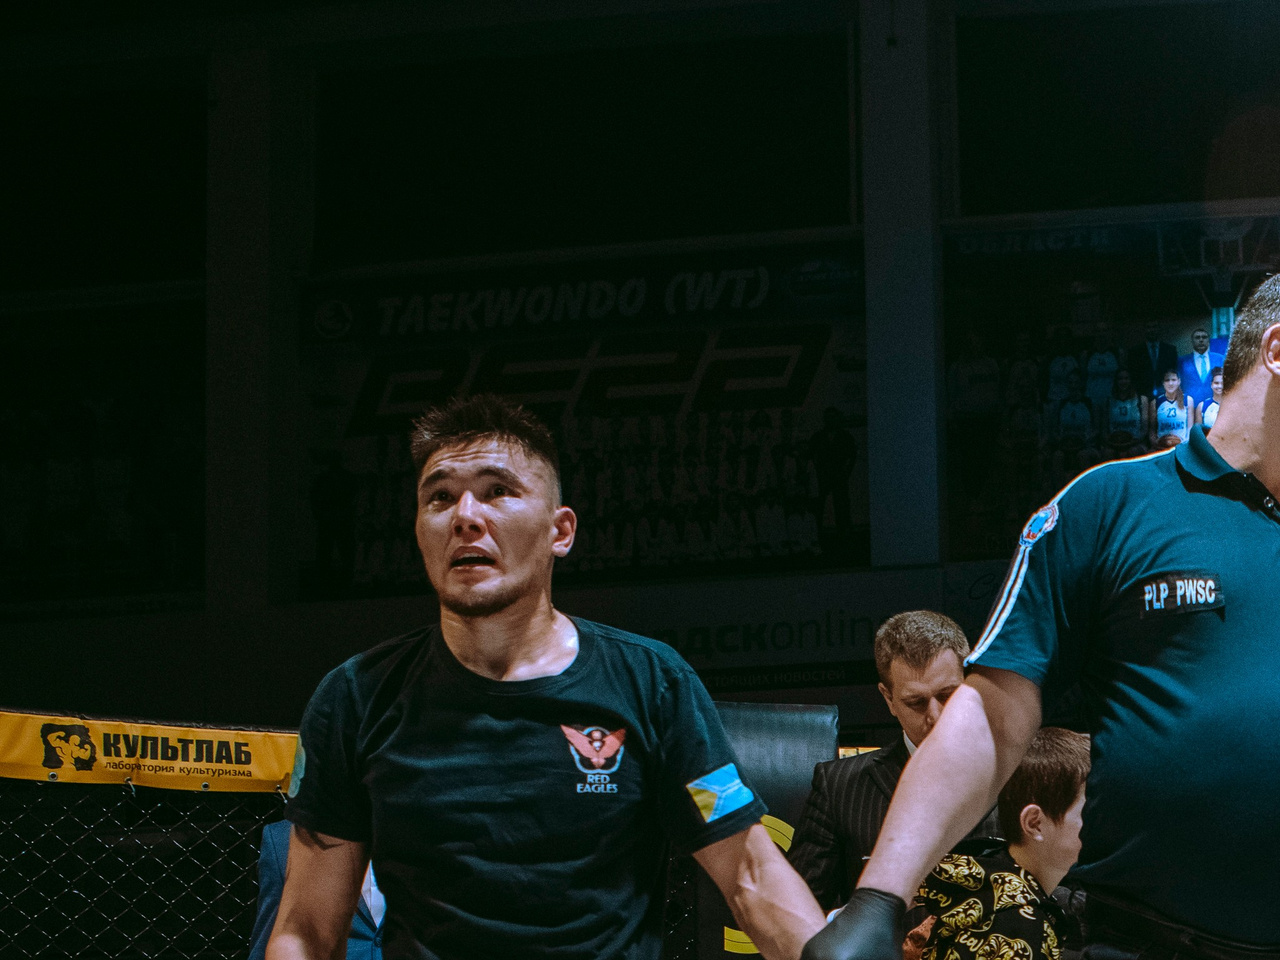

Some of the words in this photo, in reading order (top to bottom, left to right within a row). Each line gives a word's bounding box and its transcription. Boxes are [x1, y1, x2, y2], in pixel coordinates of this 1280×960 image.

[375, 276, 646, 335] TAEKWONDO
[663, 265, 770, 314] (WT)
[1166, 407, 1178, 419] 23
[1144, 580, 1169, 611] PLP
[1176, 578, 1217, 604] PWSC
[102, 732, 253, 766] КУЛЬТЛАБ
[104, 760, 175, 776] лаборатория
[179, 765, 253, 778] культуризма
[586, 774, 611, 785] RED
[576, 783, 619, 795] EAGLES
